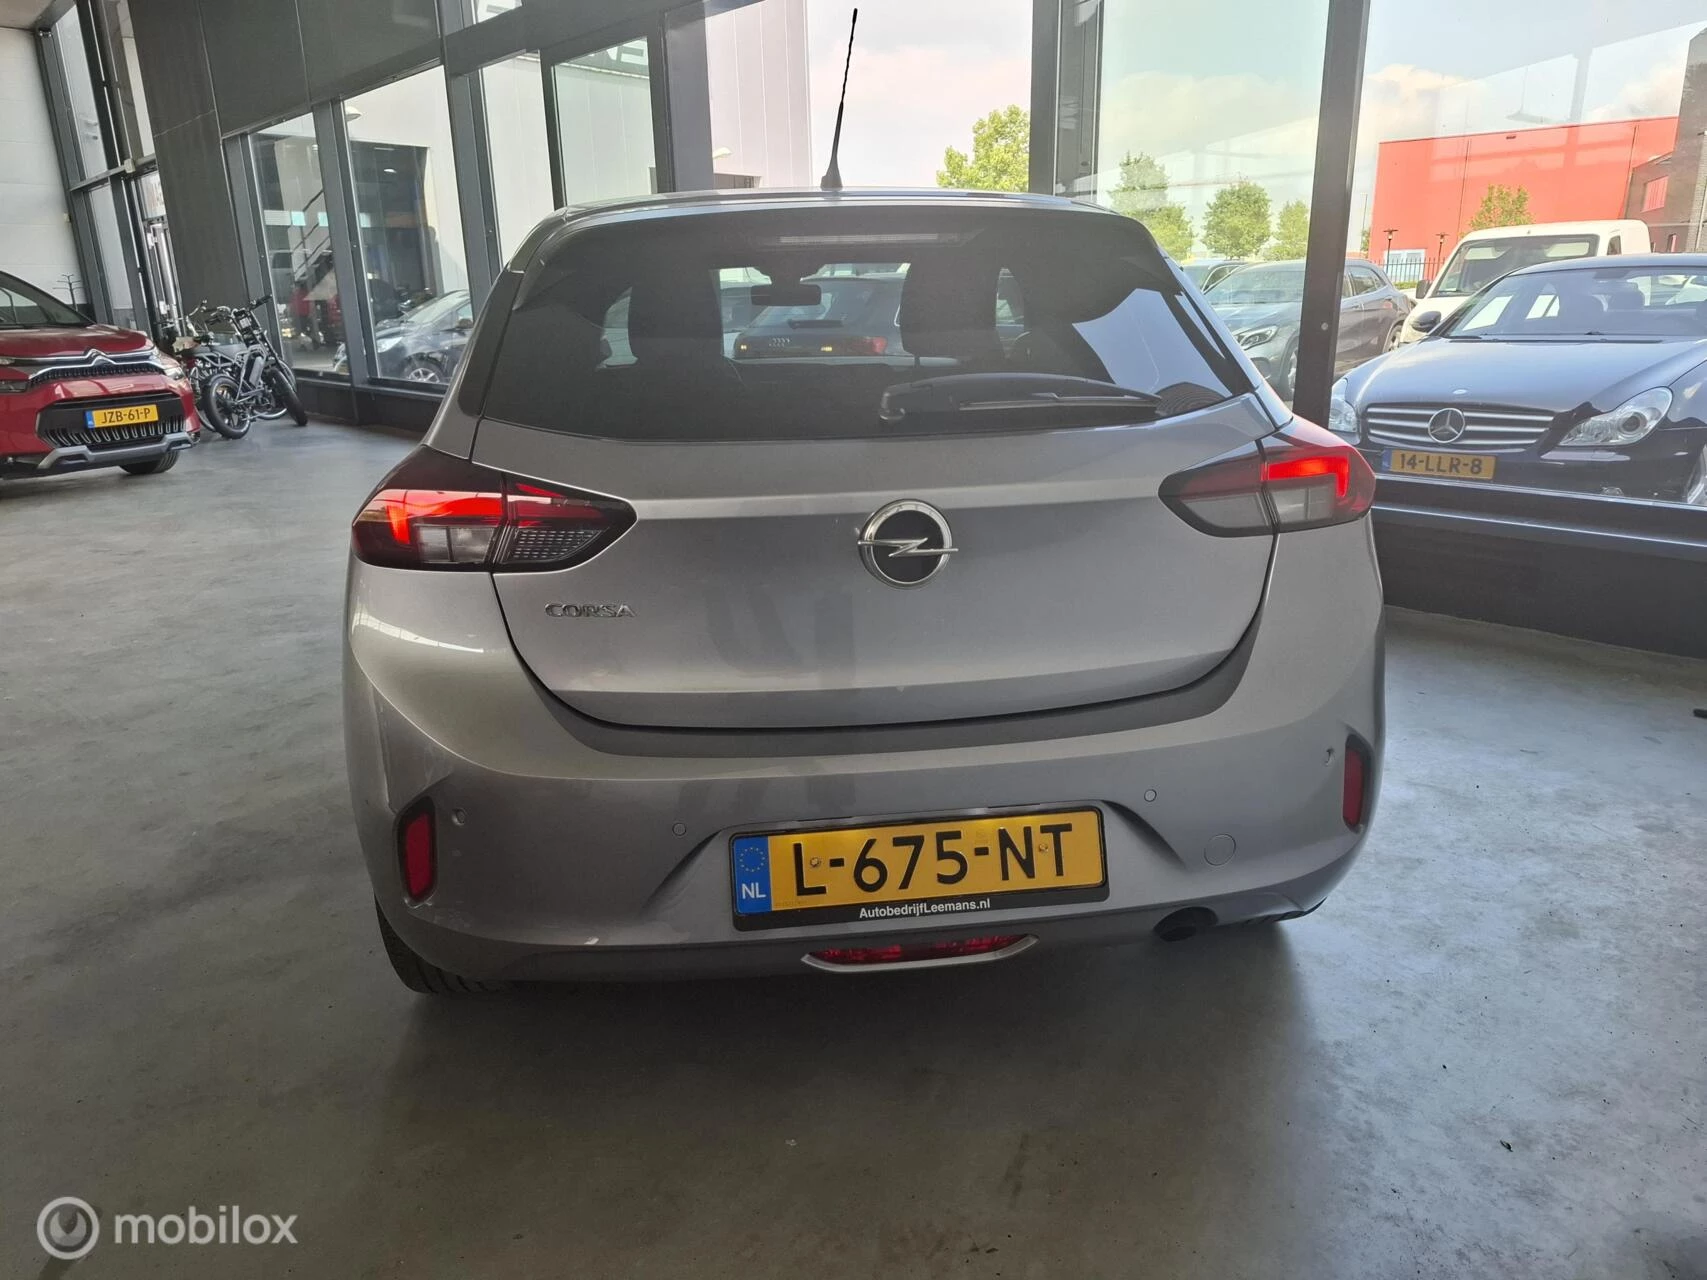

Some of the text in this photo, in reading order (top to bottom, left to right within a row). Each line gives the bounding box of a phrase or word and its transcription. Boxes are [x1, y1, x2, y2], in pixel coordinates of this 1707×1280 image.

[101, 407, 151, 424] JZB-61-P
[1400, 453, 1483, 475] 14-LLR-8
[544, 603, 637, 618] CORSA
[793, 822, 1073, 897] L-675-NT
[741, 881, 767, 900] NL
[859, 898, 991, 919] AutobedrijfLeemans.nl
